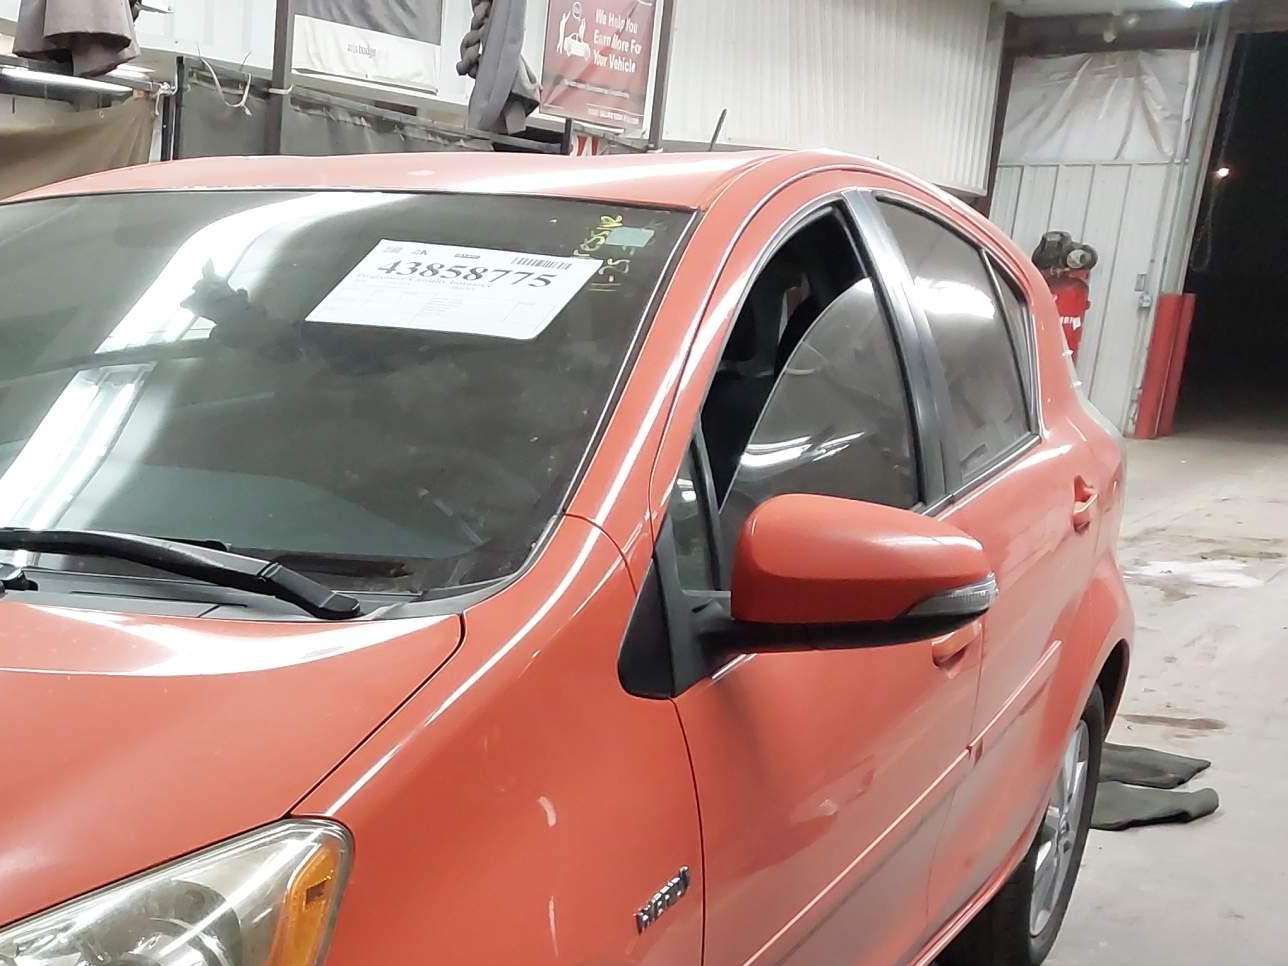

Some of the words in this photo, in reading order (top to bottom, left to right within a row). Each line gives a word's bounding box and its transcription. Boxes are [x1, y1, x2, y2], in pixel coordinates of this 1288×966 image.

[624, 16, 638, 34] You
[609, 53, 636, 73] Vehicle
[377, 259, 558, 288] 43858775
